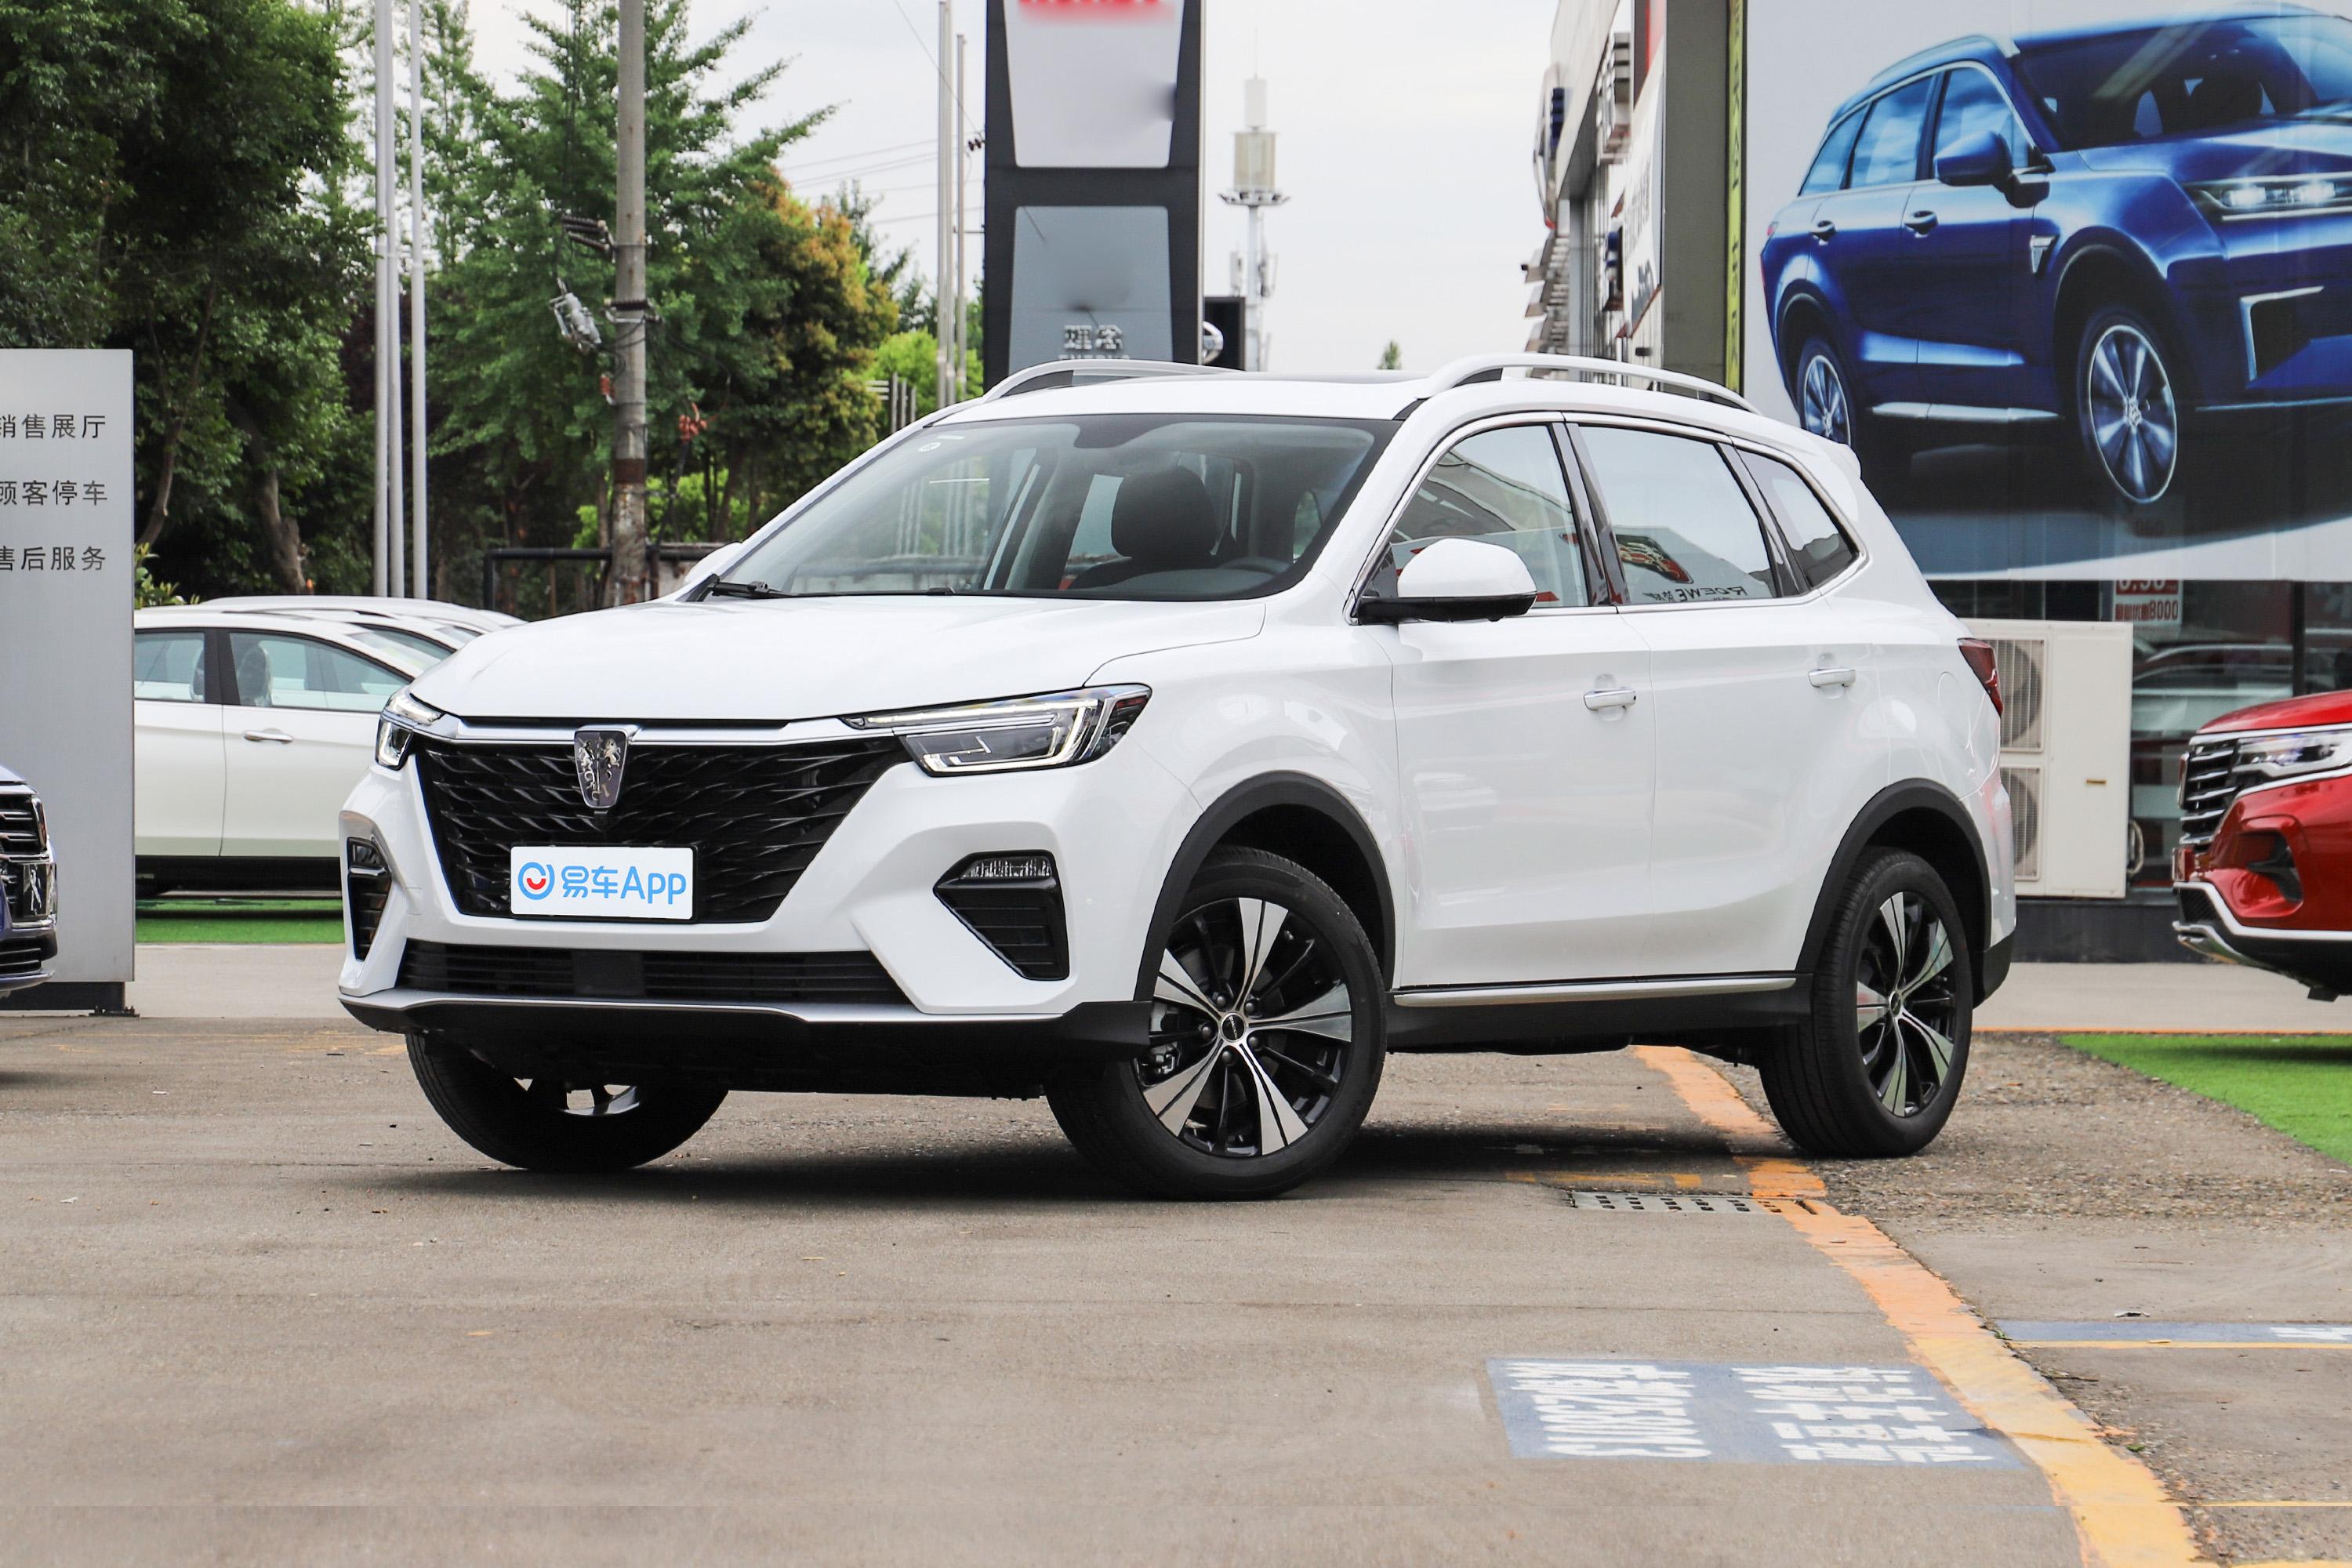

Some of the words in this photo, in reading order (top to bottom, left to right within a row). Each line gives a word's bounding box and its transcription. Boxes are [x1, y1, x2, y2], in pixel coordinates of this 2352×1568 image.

[0, 480, 107, 506] 顾客停车
[0, 546, 106, 572] 售后服务
[561, 866, 687, 905] 易车App
